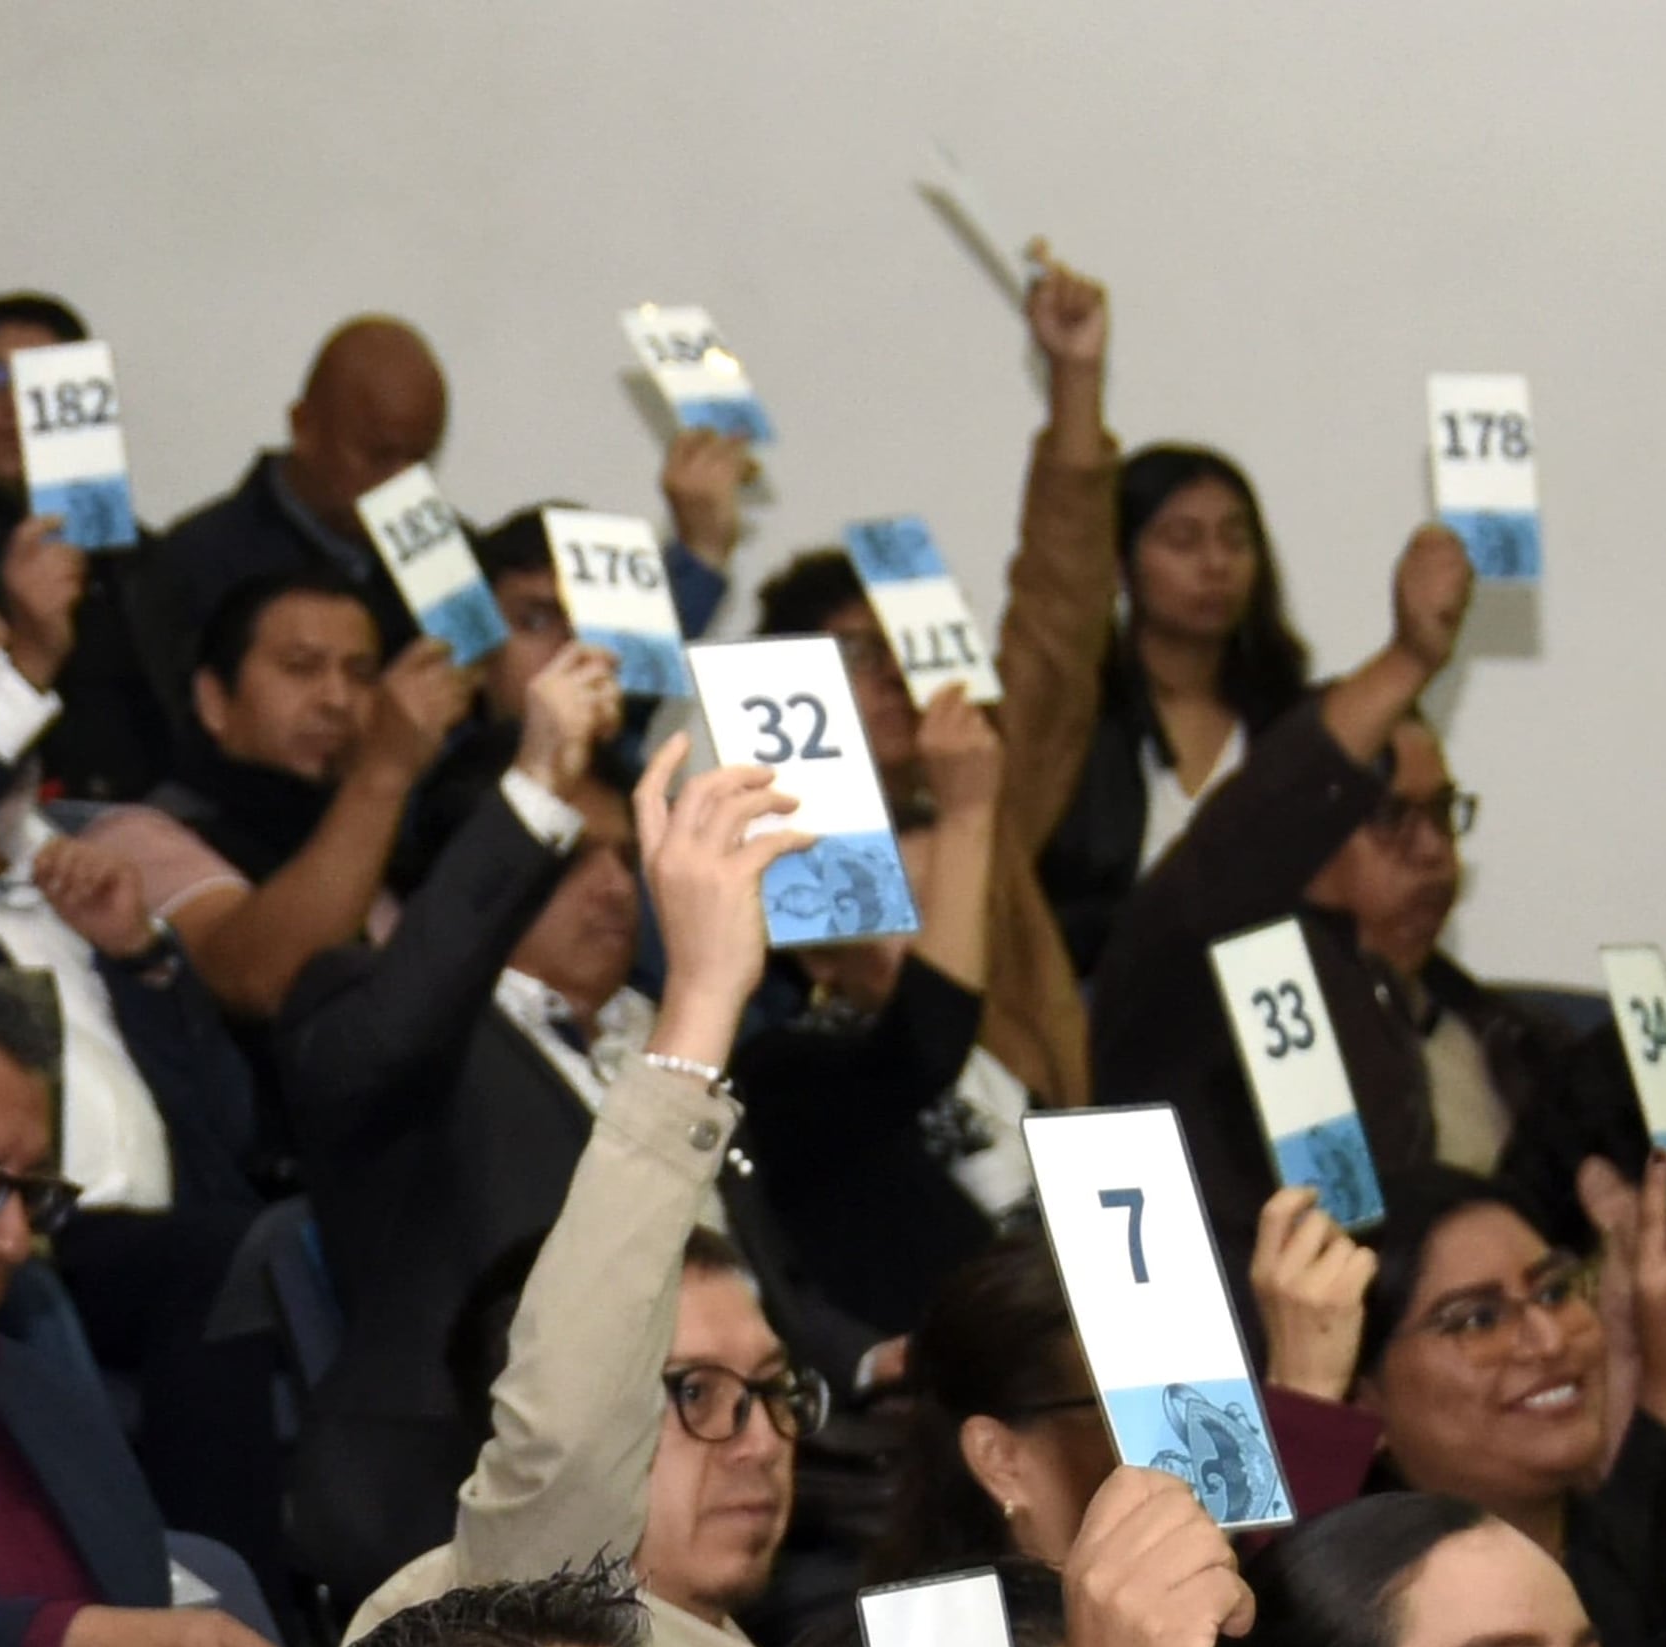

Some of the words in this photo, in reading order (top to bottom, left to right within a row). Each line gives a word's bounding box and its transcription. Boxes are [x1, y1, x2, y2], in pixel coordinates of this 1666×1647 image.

[29, 380, 113, 433] 182
[1441, 412, 1532, 461] 178
[565, 540, 661, 592] 176
[900, 621, 976, 673] 177
[740, 692, 842, 764] 32
[1252, 979, 1316, 1059] 33
[1098, 1187, 1150, 1284] 7
